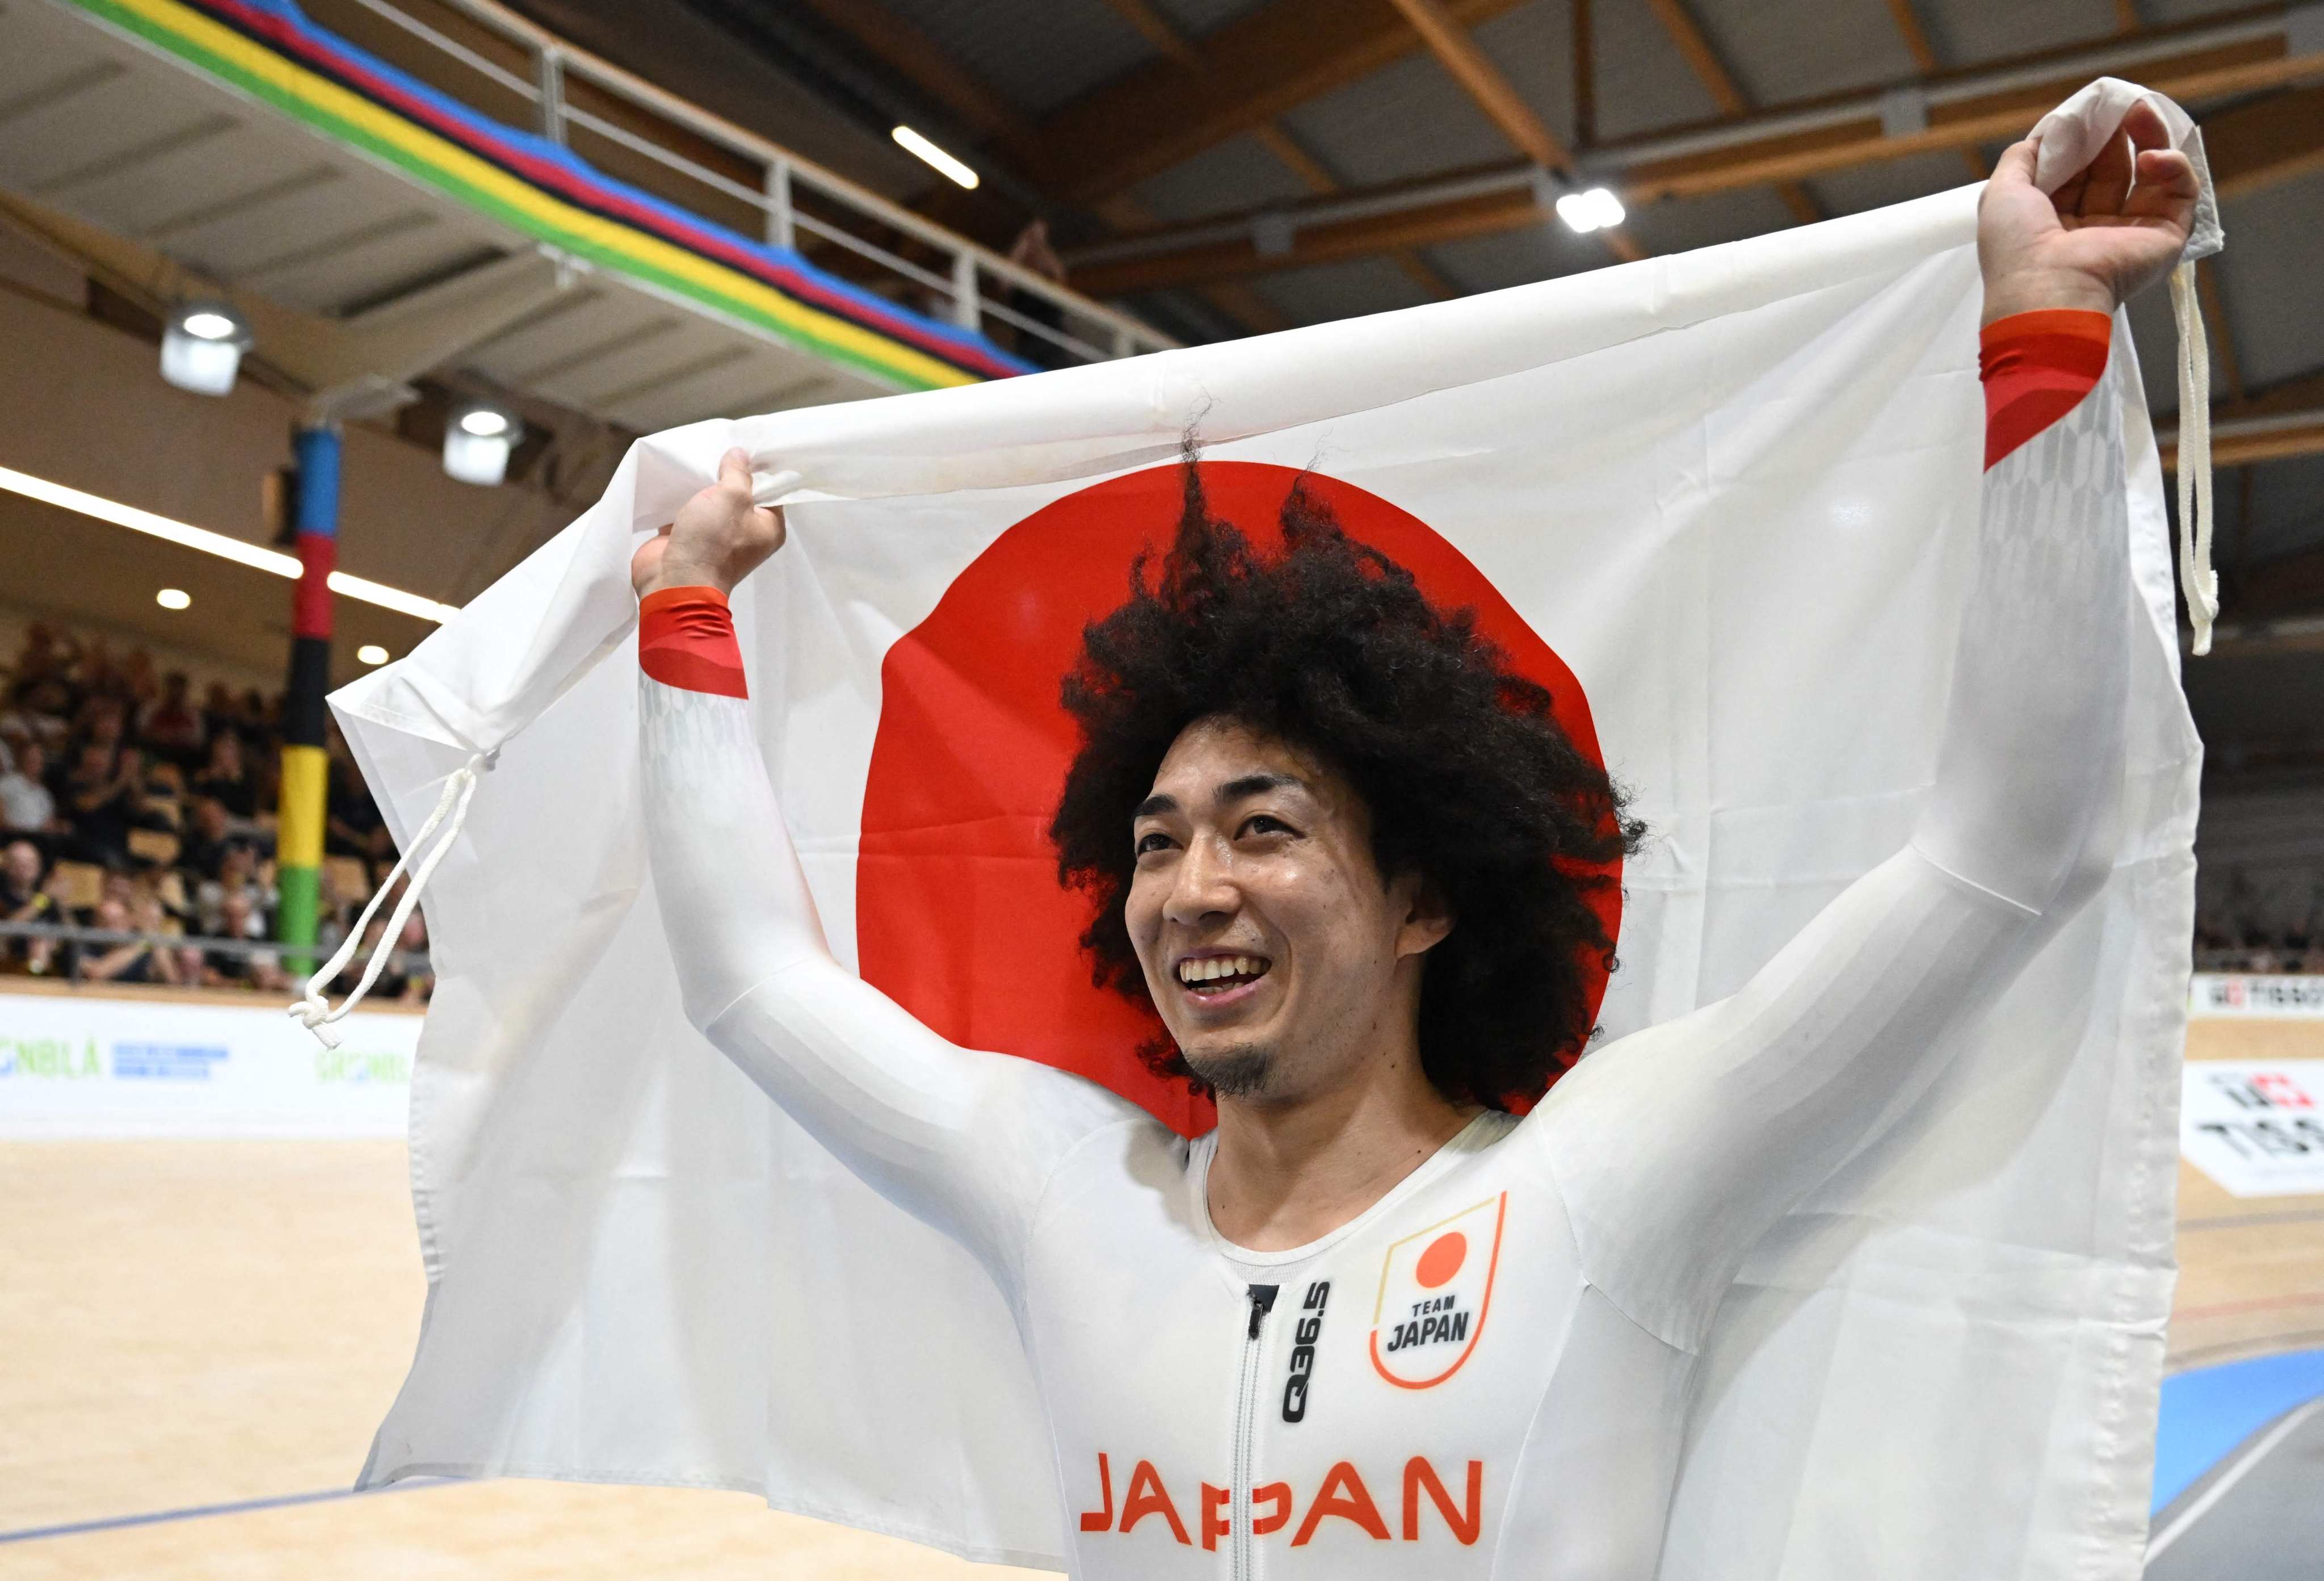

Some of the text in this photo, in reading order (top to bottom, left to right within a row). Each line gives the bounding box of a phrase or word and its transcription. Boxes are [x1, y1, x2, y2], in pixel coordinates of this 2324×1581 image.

[1387, 1311, 1469, 1352] JAPAN
[1411, 1295, 1455, 1318] TEAM
[1282, 1281, 1330, 1423] Q36.5
[1080, 1453, 1483, 1552] JAPAN
